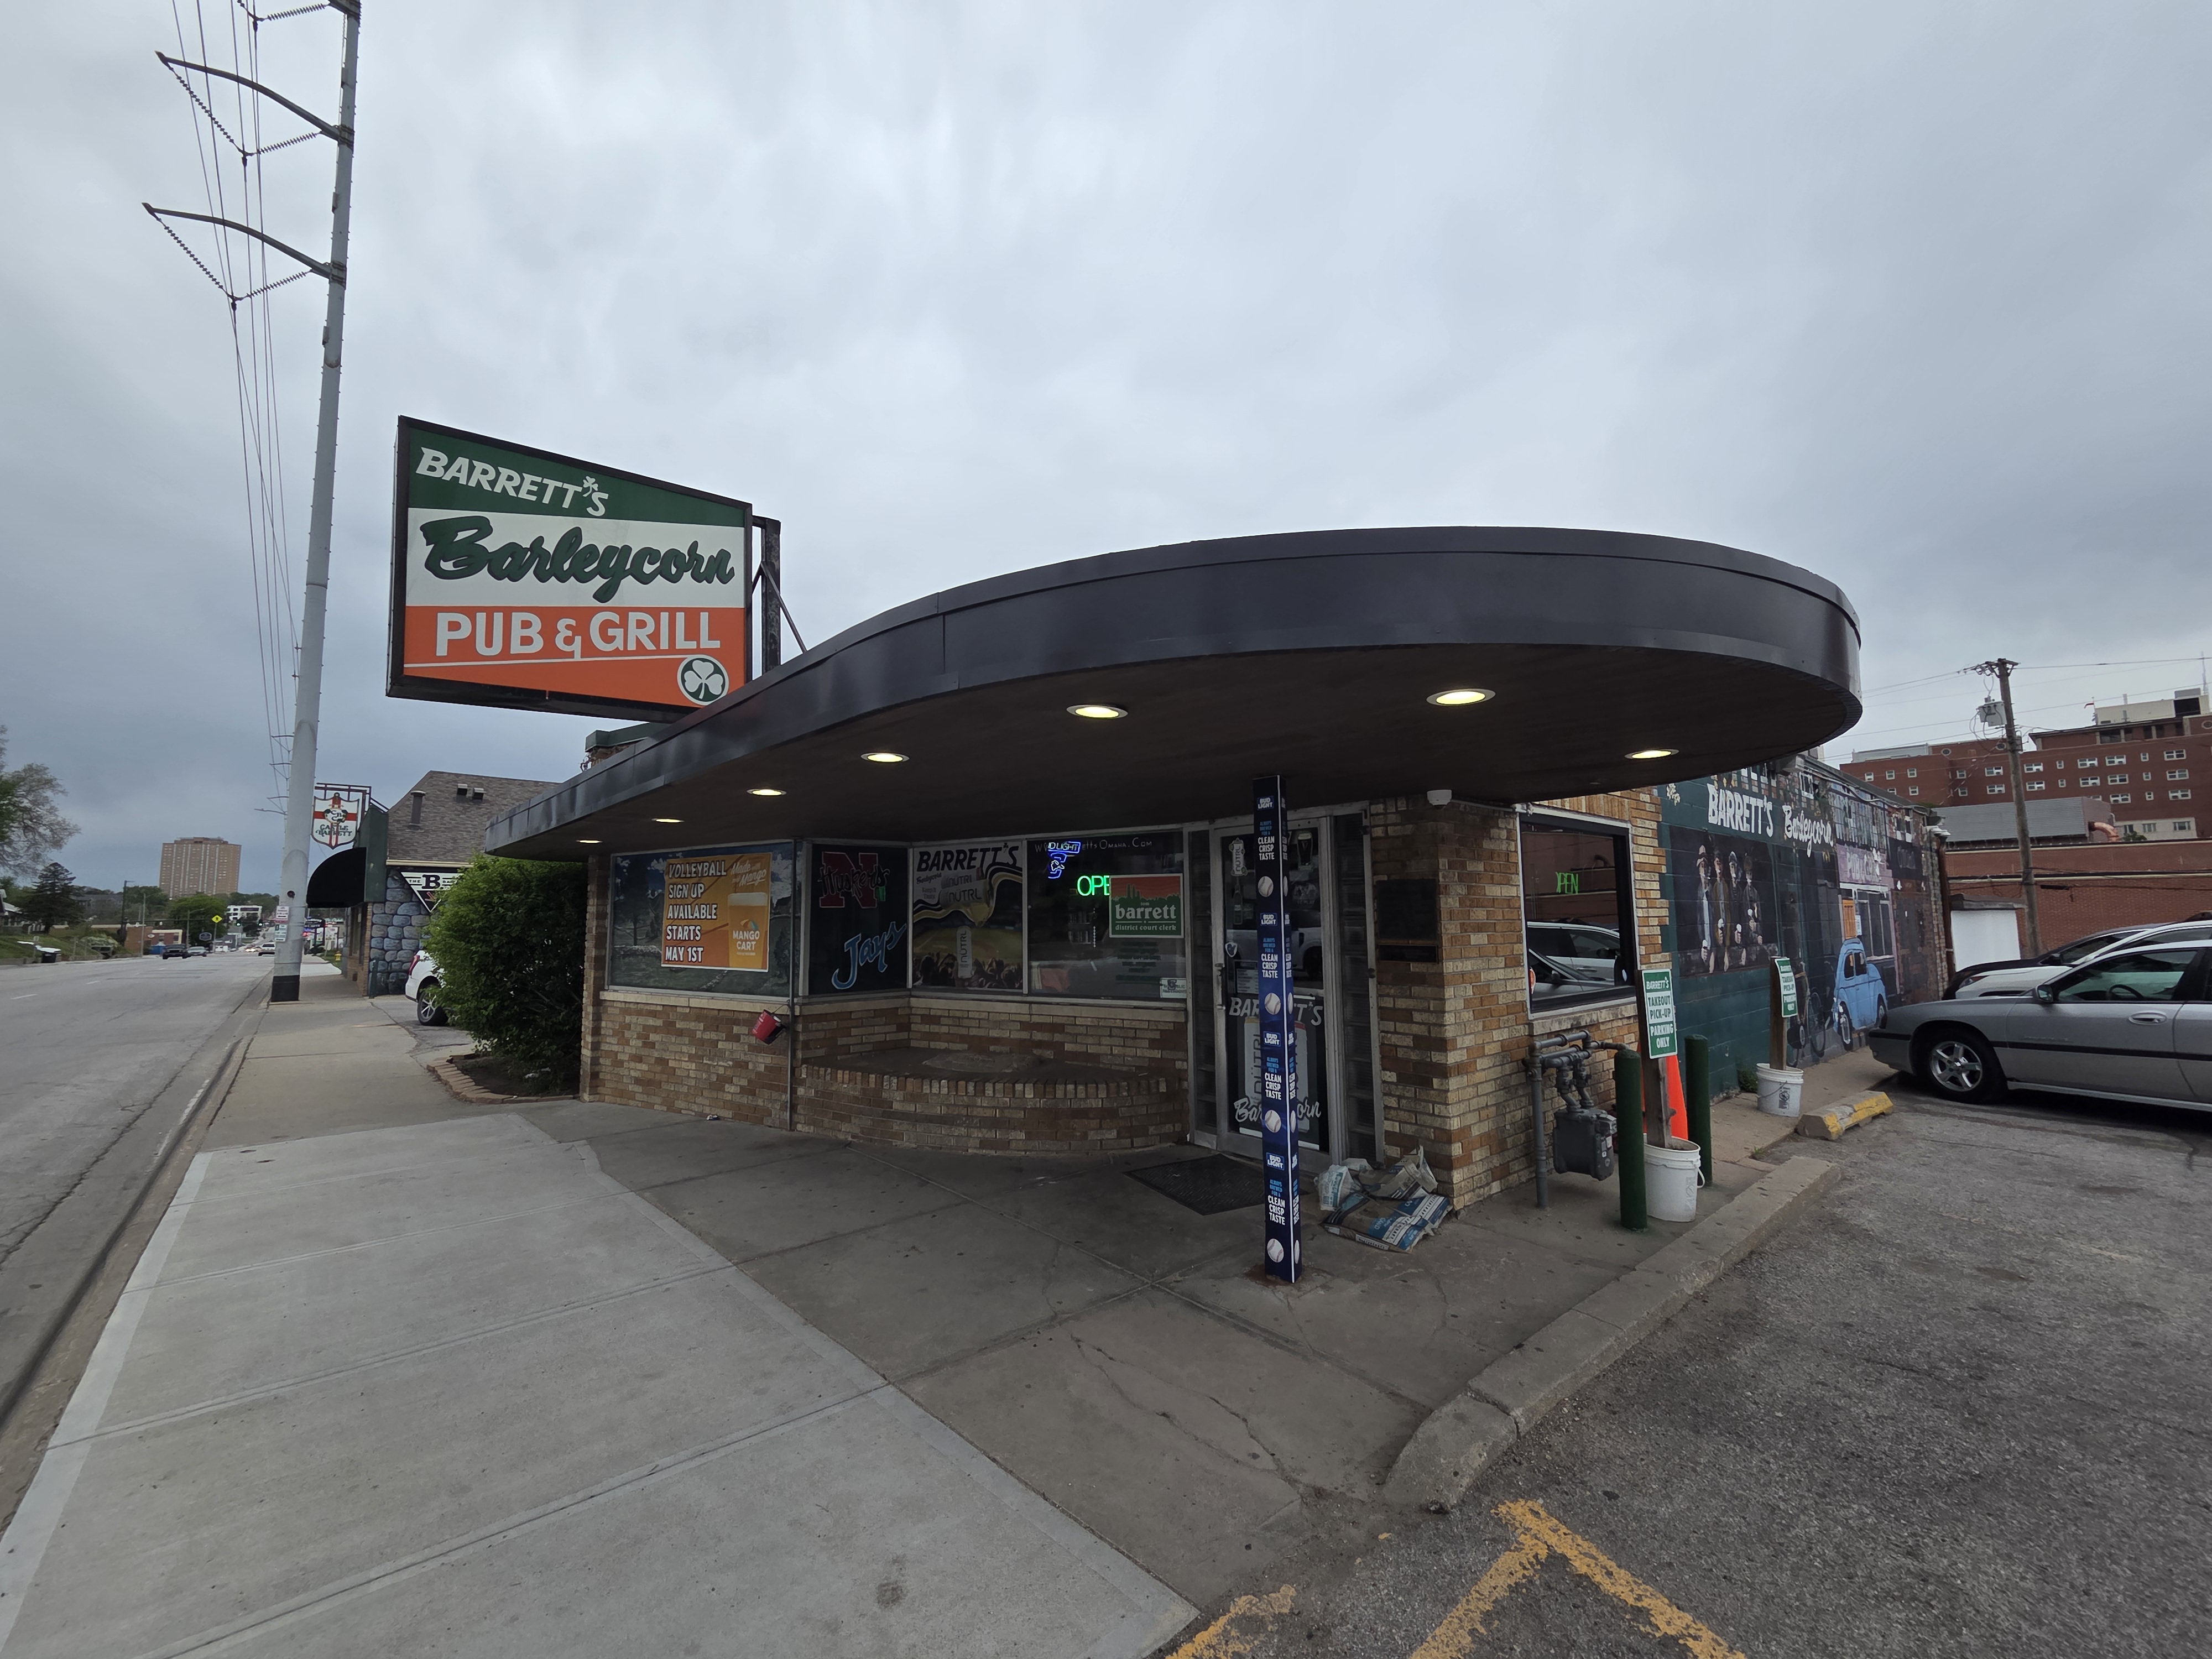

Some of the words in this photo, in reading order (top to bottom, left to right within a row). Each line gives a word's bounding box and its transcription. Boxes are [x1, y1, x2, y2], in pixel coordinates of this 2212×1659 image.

[415, 447, 609, 517] BARRETT'S
[420, 515, 735, 604] Barleycorn
[436, 612, 544, 656] PUB
[555, 618, 582, 659] &
[589, 611, 721, 652] GRILL
[1707, 783, 1773, 837] BARRETT'S
[1258, 836, 1275, 845] CLEAN
[1259, 844, 1274, 853] CRISP
[916, 842, 1019, 872] BARRETT'S
[1259, 852, 1275, 861] TASTE
[669, 860, 727, 878] VOLLEYBALL
[421, 874, 441, 889] B
[817, 864, 891, 899] Huskers
[668, 883, 689, 899] SIGN
[691, 883, 705, 899] UP
[667, 904, 718, 920] AVAILABLE
[1115, 904, 1177, 920] barrett
[665, 925, 701, 941] STARTS
[732, 930, 760, 941] MANGO
[736, 941, 757, 951] CART
[665, 946, 685, 961] MAY
[687, 947, 704, 963] 1ST
[831, 921, 907, 990] Jays
[1261, 953, 1279, 962] CLEAN
[1262, 961, 1277, 970] CRISP
[1262, 969, 1279, 978] TASTE
[1646, 976, 1669, 990] BARRETT'S
[1647, 995, 1671, 1007] TAKEOUT
[1229, 997, 1324, 1026] BART'S
[1650, 1008, 1671, 1020] PICK-UP
[1650, 1023, 1673, 1037] PARKING
[1656, 1036, 1670, 1048] ONLY
[1264, 1072, 1282, 1083] CLEAN
[1265, 1081, 1281, 1092] CRISP
[1265, 1089, 1282, 1100] TASTE
[1267, 1159, 1284, 1169] LIGHT
[1269, 1154, 1281, 1162] BUD
[1267, 1194, 1285, 1208] CLEAN
[1269, 1203, 1285, 1216] CRISP
[1269, 1212, 1286, 1226] TASTE
